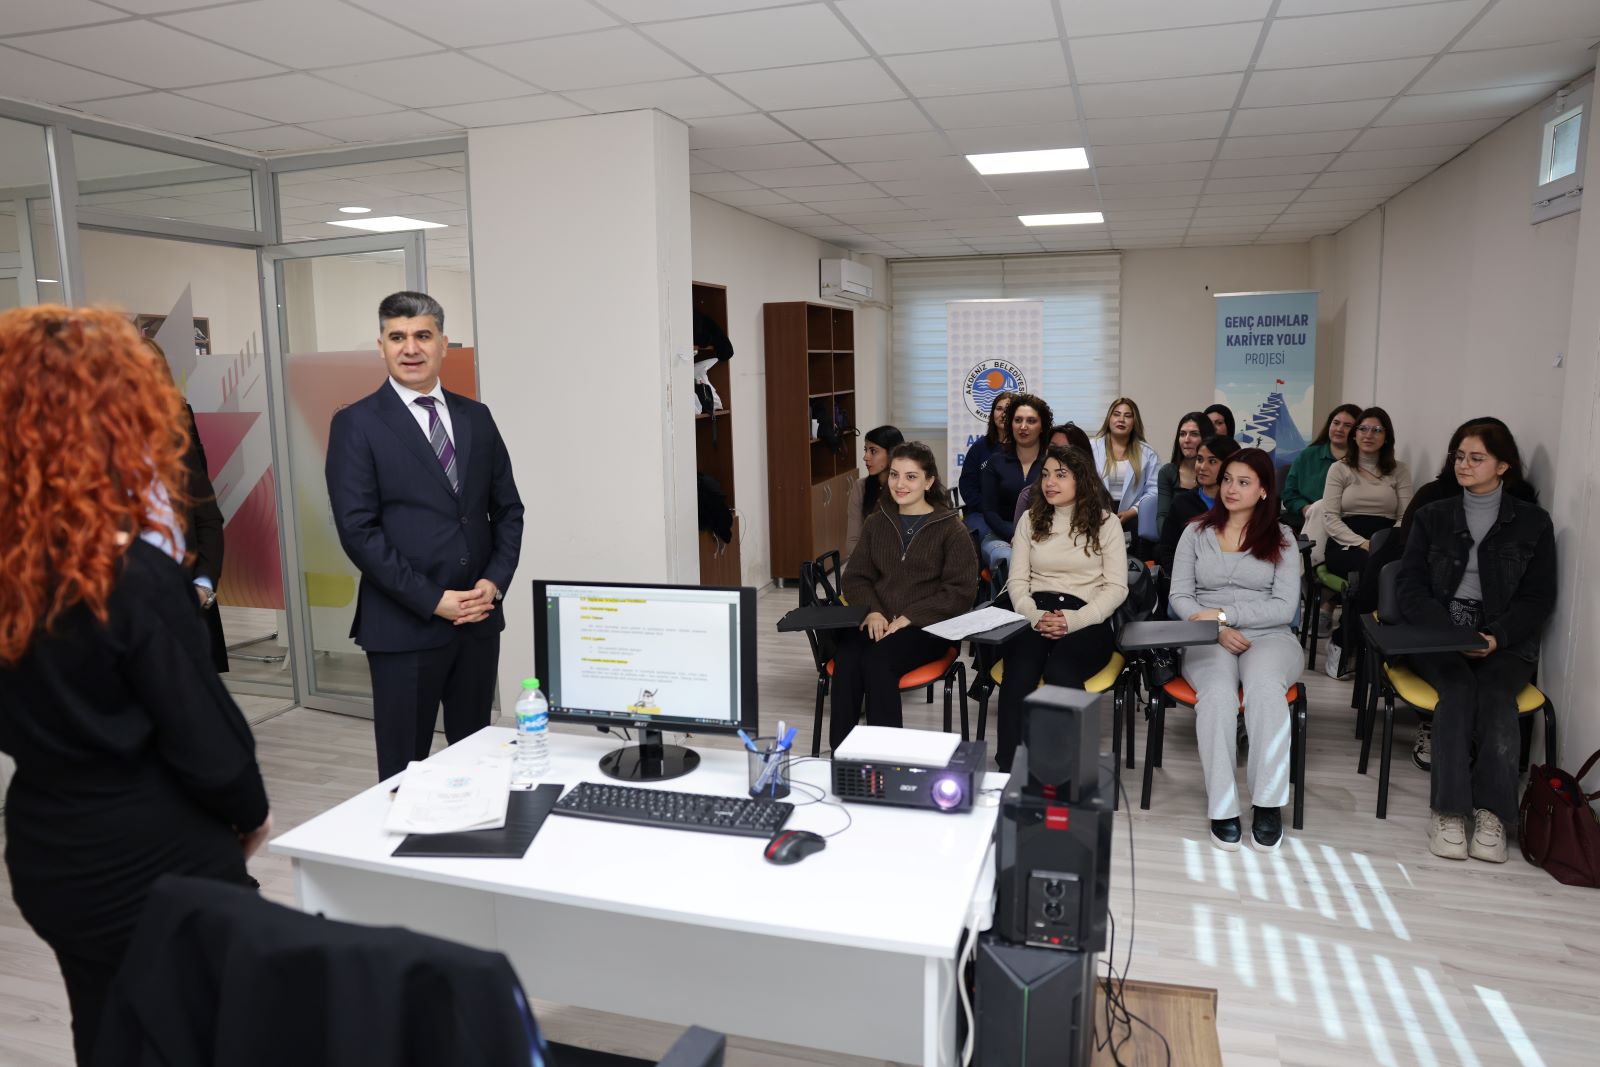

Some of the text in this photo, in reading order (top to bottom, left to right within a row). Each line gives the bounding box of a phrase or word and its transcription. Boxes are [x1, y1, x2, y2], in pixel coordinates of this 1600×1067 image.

[1225, 314, 1309, 331] GENÇ ADIMLAR
[1226, 332, 1306, 347] KARİYER YOLU
[1245, 350, 1285, 367] PROJESİ
[966, 364, 988, 395] AKDENİZ
